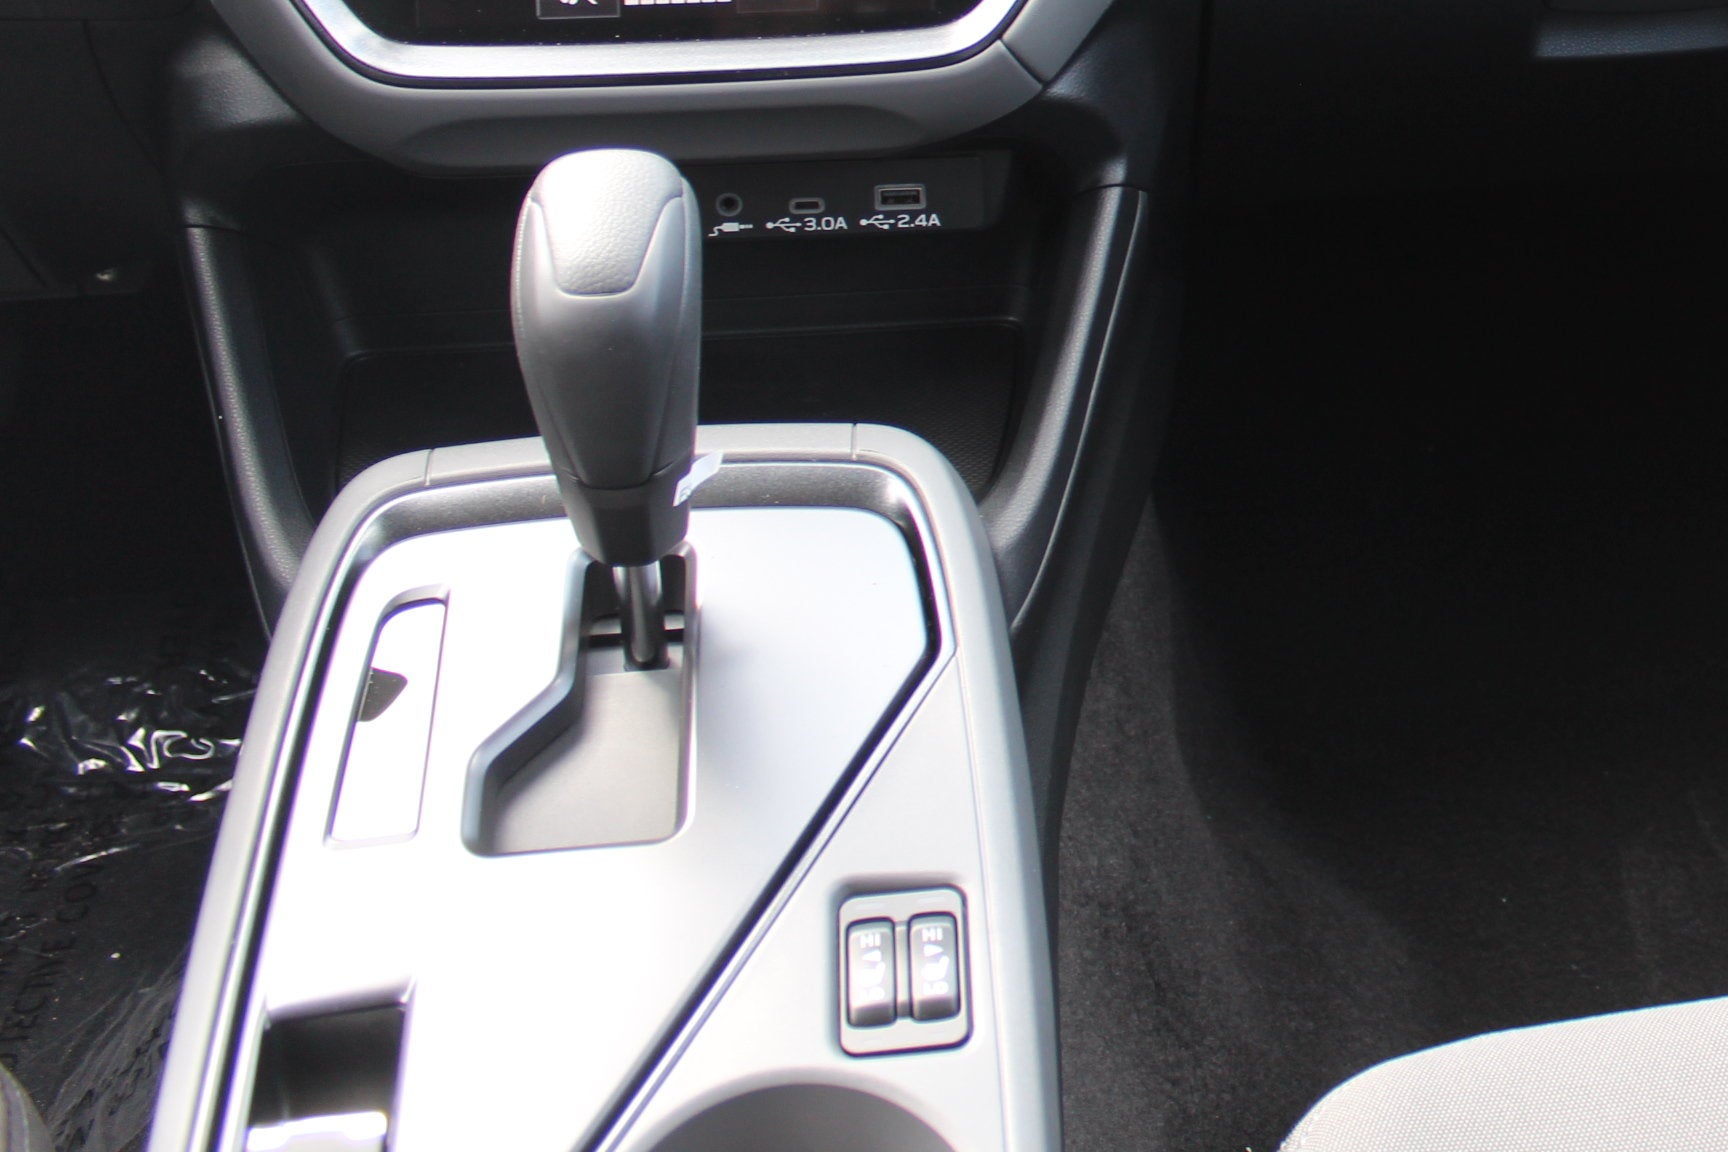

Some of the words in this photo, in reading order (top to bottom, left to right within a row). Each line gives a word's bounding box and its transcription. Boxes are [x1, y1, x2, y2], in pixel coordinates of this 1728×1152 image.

[803, 216, 848, 231] 3.0A
[896, 213, 942, 228] 2.4A
[859, 933, 882, 949] HI
[921, 927, 944, 942] HI
